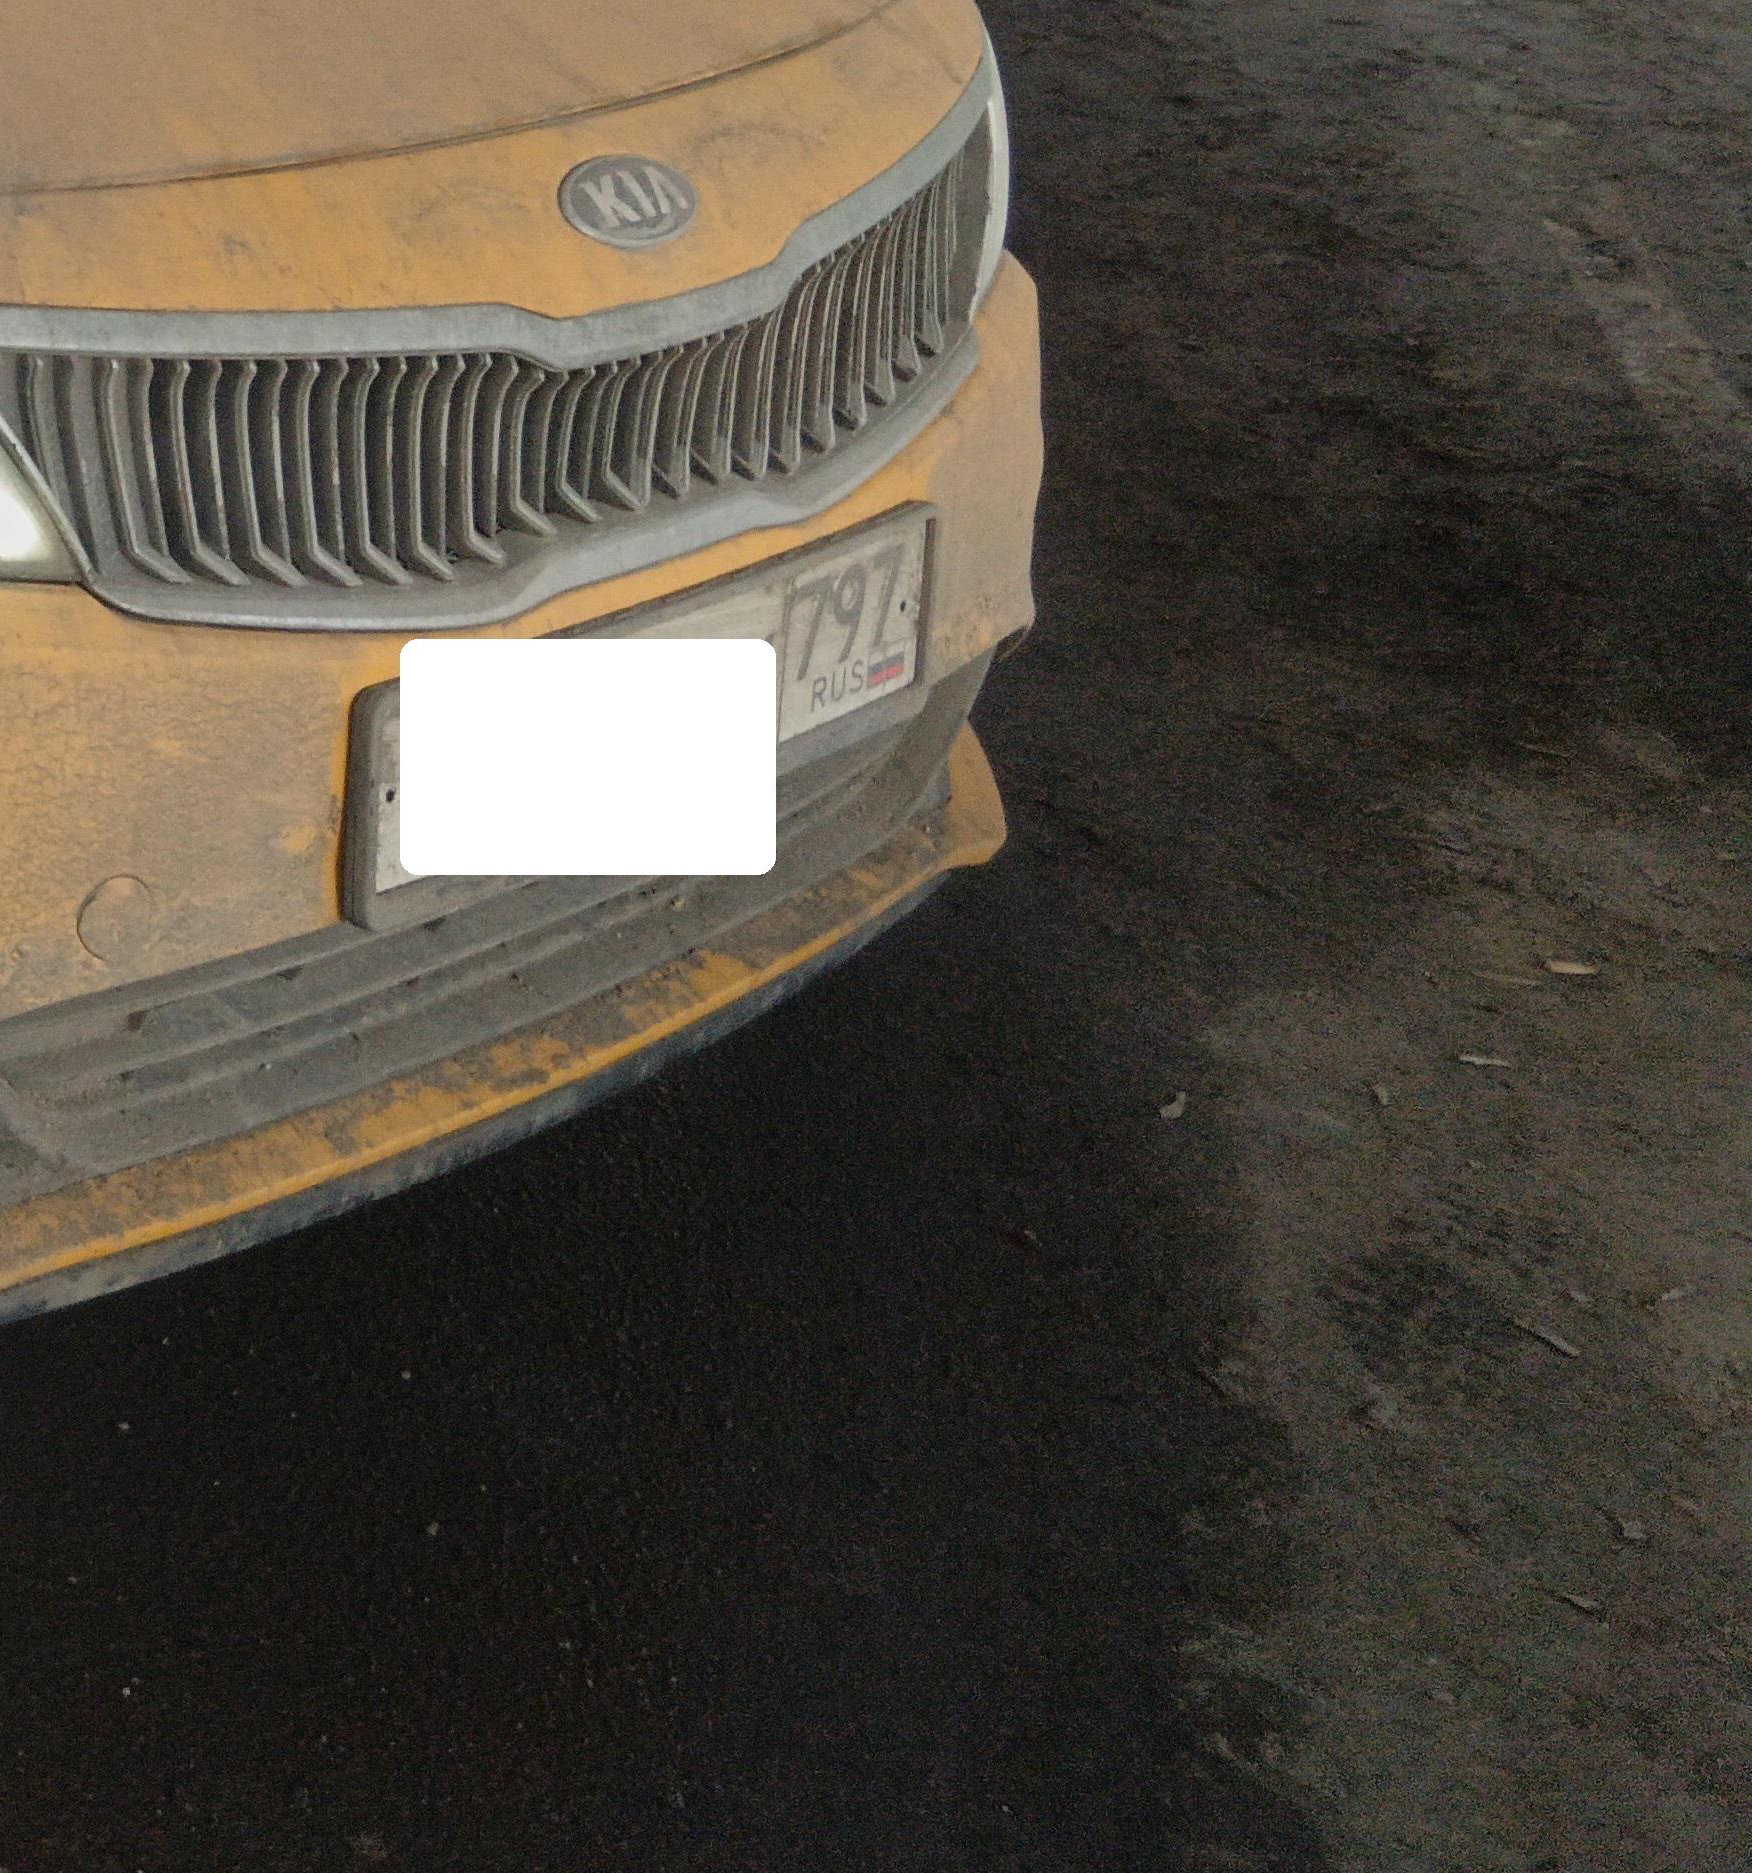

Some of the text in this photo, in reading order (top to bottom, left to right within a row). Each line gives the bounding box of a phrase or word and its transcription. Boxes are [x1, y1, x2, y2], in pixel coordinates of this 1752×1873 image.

[578, 165, 689, 228] KIA
[785, 542, 905, 680] 797
[811, 659, 864, 712] RUS
